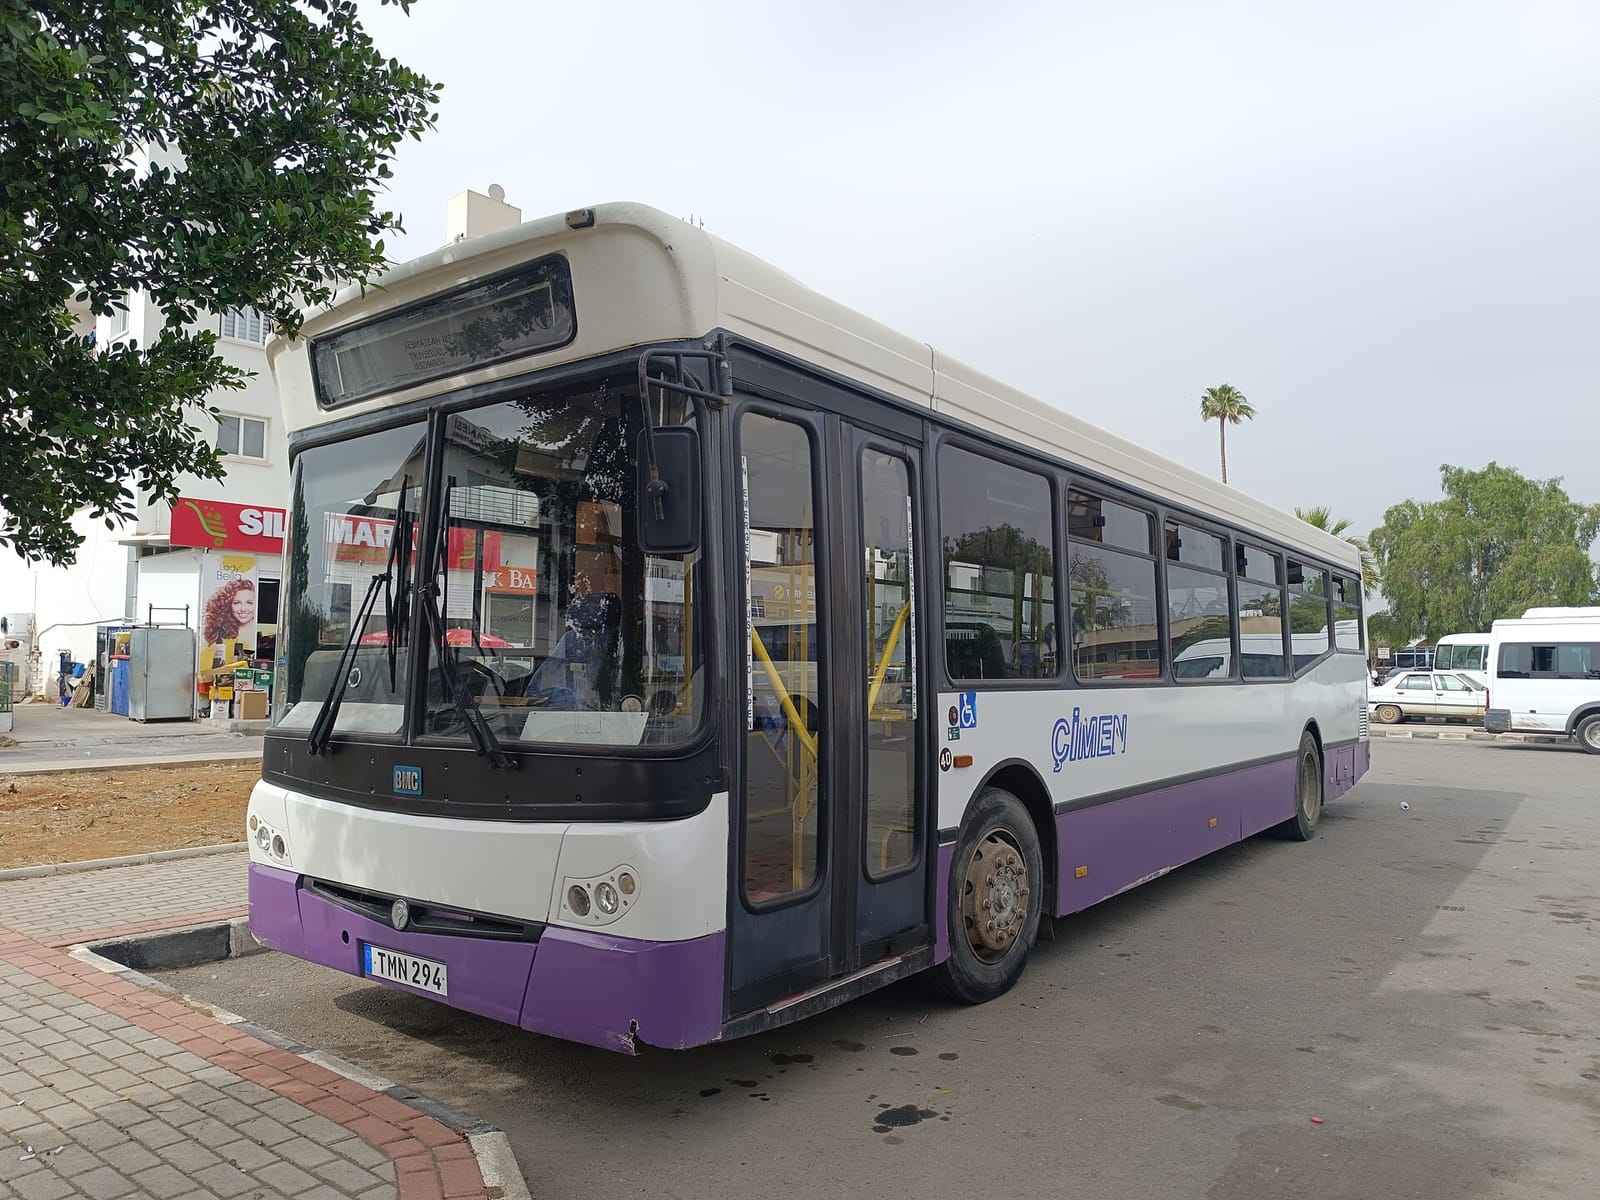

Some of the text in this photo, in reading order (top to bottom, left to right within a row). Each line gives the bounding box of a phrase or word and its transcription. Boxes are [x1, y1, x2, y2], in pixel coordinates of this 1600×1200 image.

[217, 571, 242, 581] Bella
[220, 563, 240, 573] Lady
[509, 569, 537, 590] BA
[1052, 707, 1127, 773] ÇİMEN
[941, 751, 951, 768] 40
[395, 770, 418, 790] BMC
[378, 952, 441, 990] TMN 294
